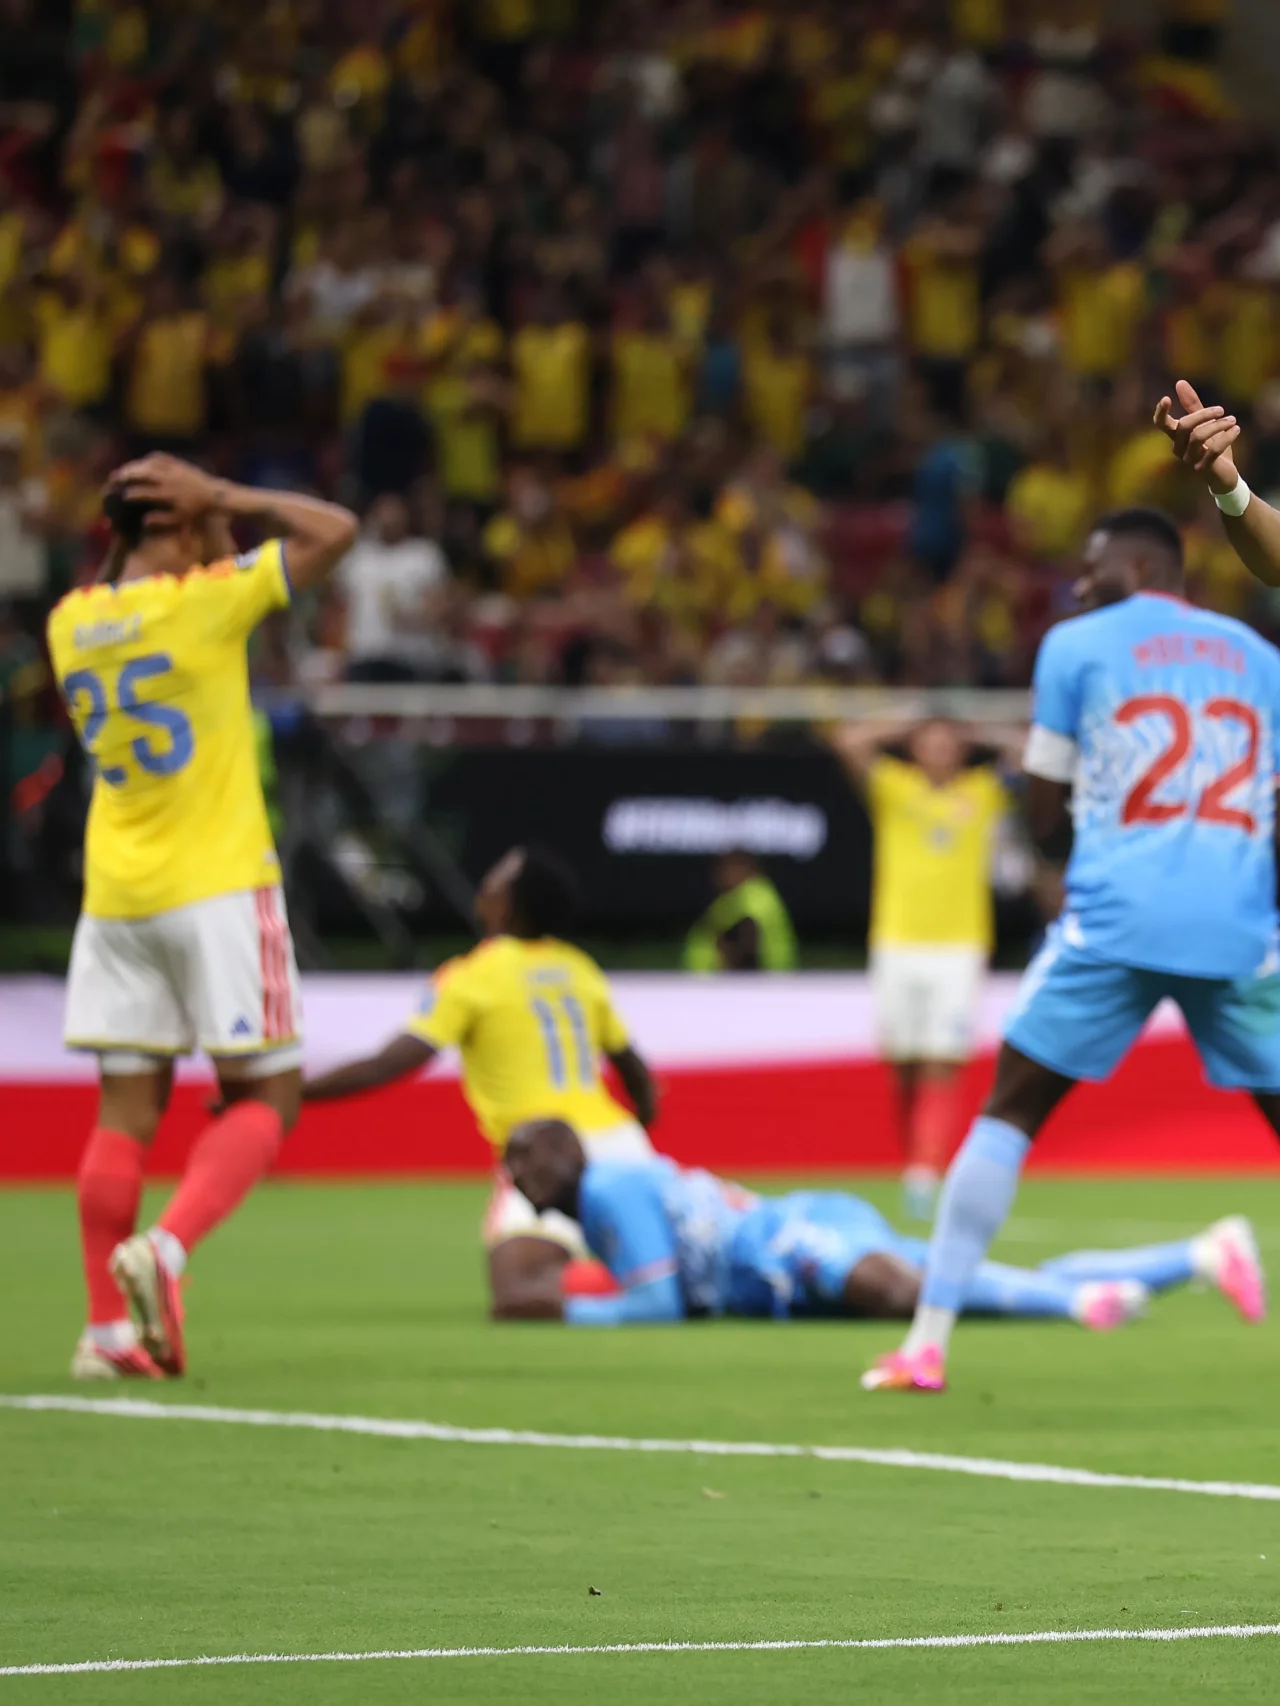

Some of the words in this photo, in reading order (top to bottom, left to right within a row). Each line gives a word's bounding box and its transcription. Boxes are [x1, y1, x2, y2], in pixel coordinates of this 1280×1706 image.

[63, 651, 196, 789] 25
[1113, 692, 1258, 837] 22
[530, 995, 597, 1093] 11
